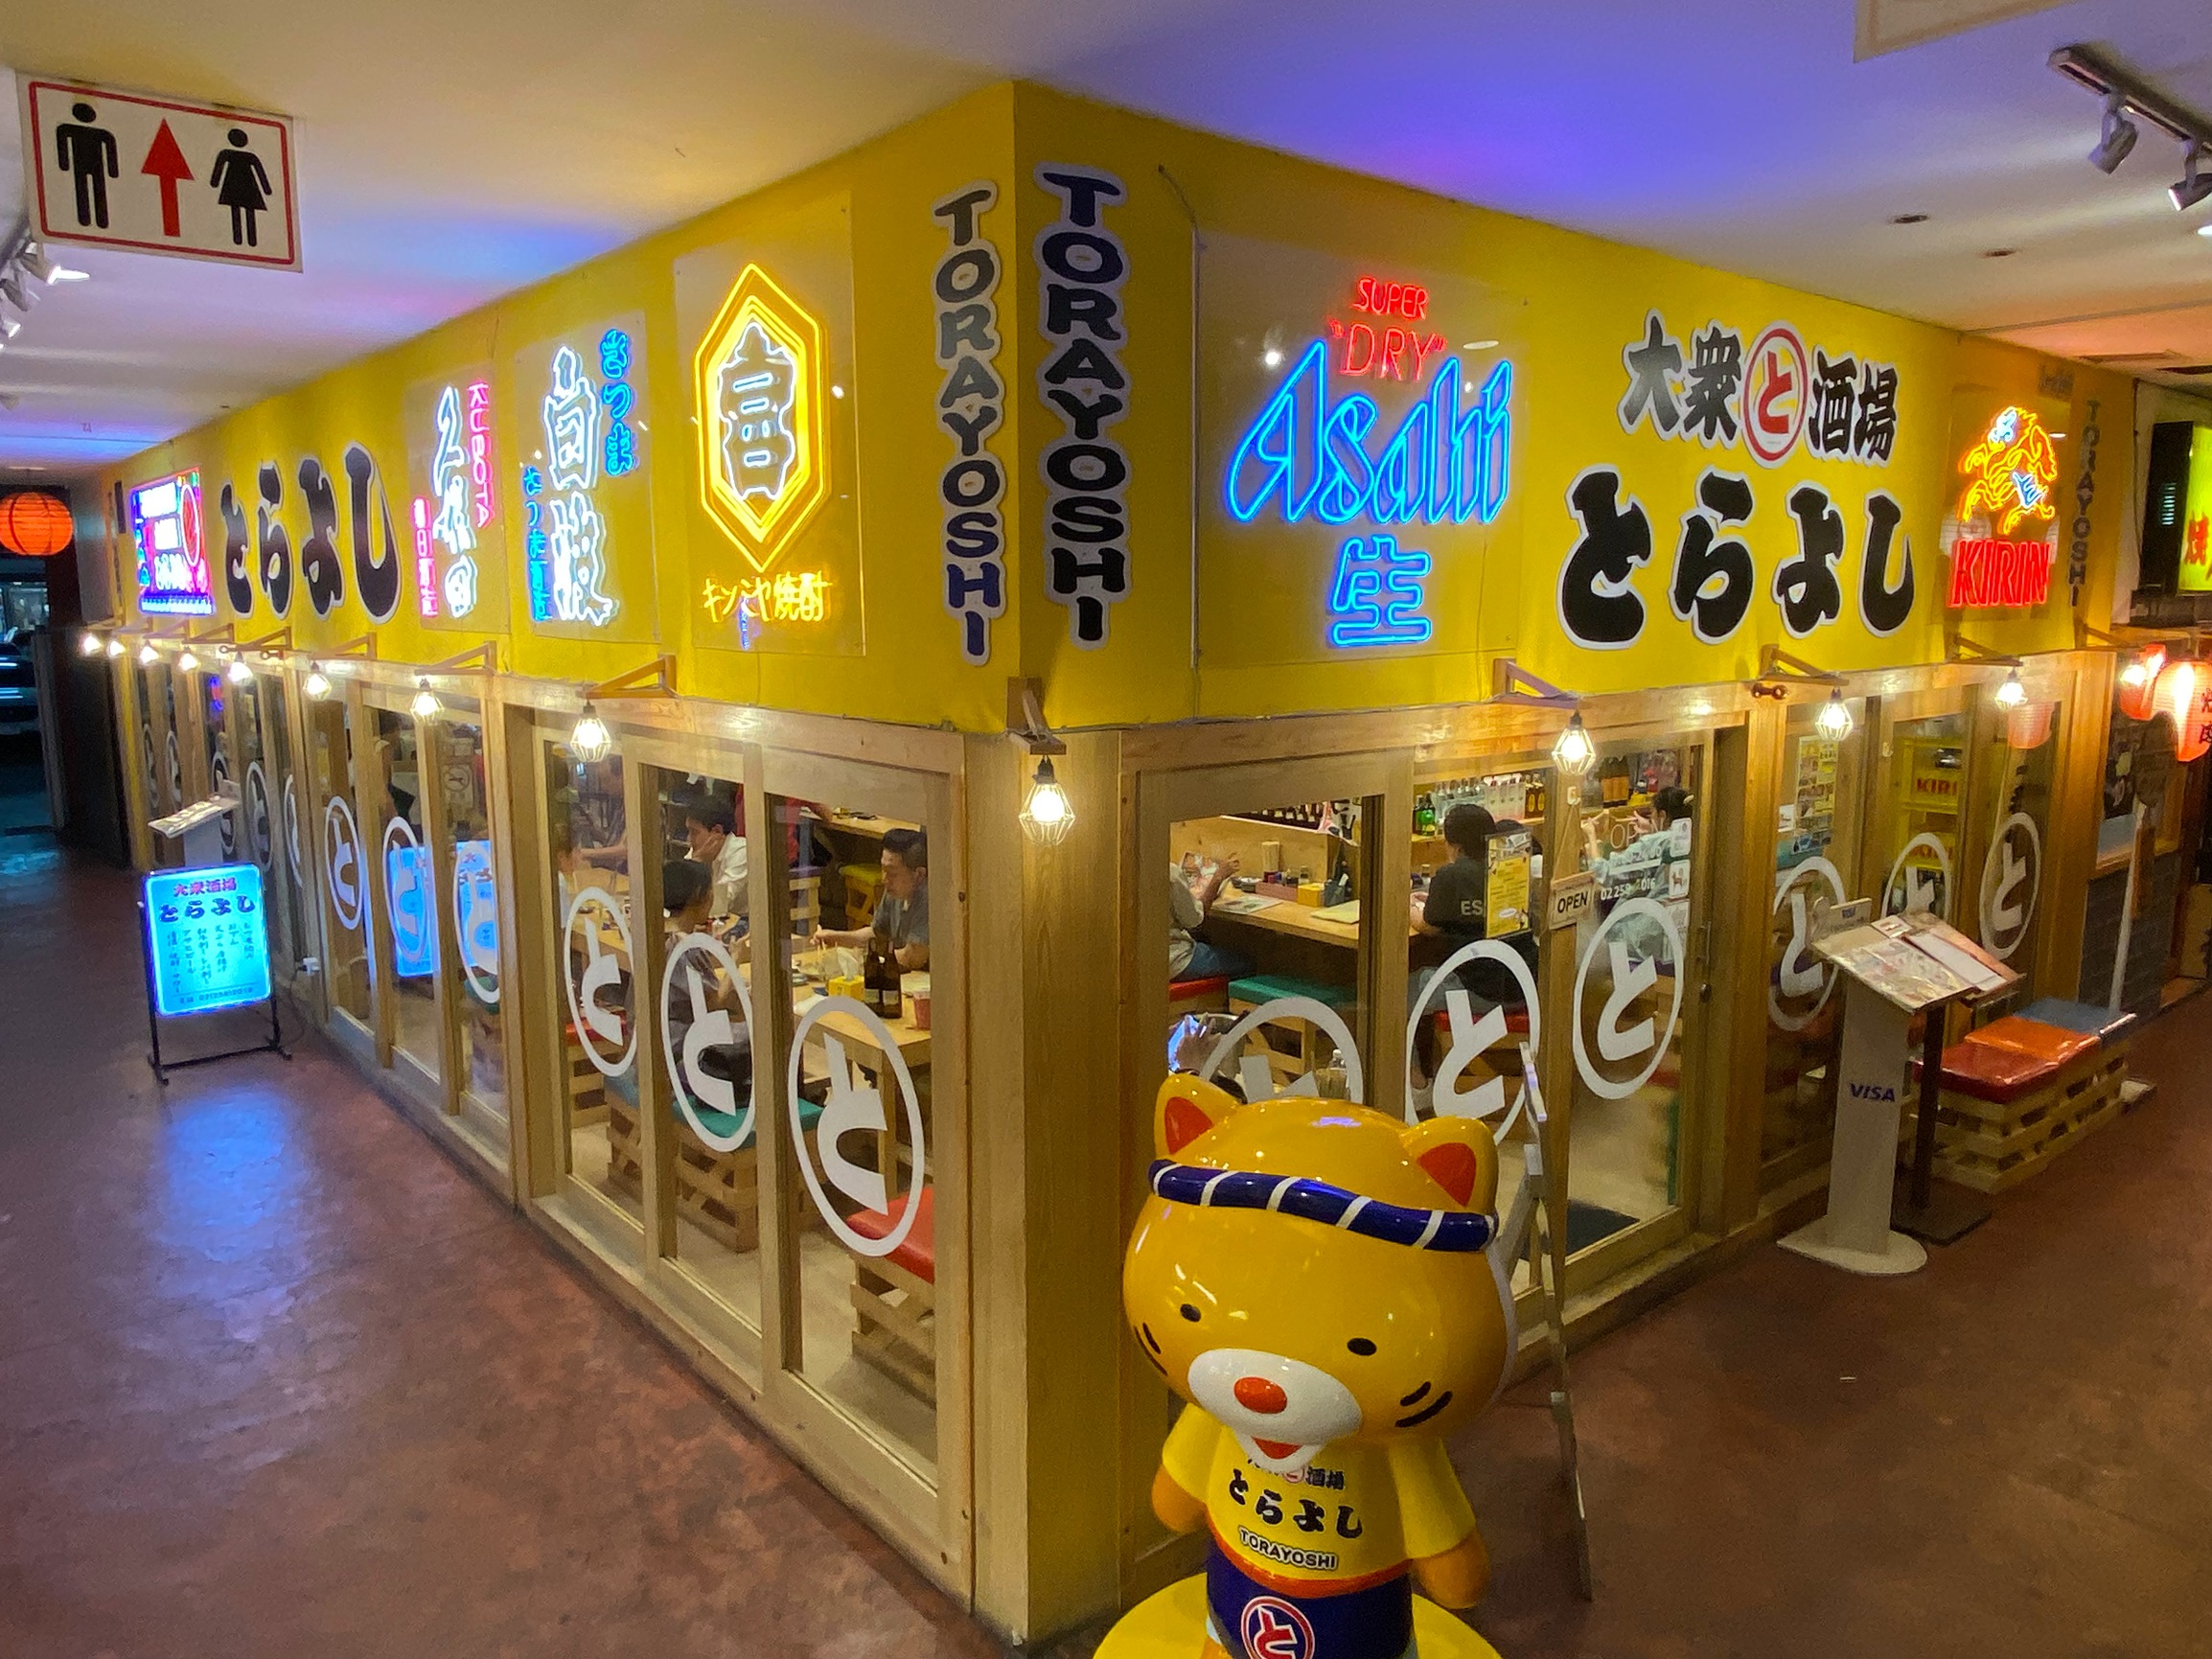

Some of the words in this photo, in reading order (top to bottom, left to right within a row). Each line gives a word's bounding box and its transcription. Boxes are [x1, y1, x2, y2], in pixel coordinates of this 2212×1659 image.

[1352, 276, 1428, 320] SUPER
[934, 189, 1001, 657] TORAYOSHI
[1042, 172, 1126, 641] TORAYOSHI
[1228, 340, 1511, 524] Asahi
[469, 383, 493, 528] KUBOTA
[221, 447, 400, 618] とらよし
[1562, 471, 1915, 642] とらよし
[703, 571, 832, 622] キンミヤ焼酎
[1332, 535, 1431, 646] 生
[1949, 538, 2053, 609] KIRIN
[1917, 778, 1958, 795] KIRI
[159, 895, 255, 922] とらよし
[173, 877, 238, 897] 大衆酒場
[1557, 891, 1589, 913] OPEN
[1850, 1083, 1895, 1102] VISA
[1230, 1468, 1363, 1538] とらよし
[1240, 1529, 1336, 1568] TORAYOSHI
